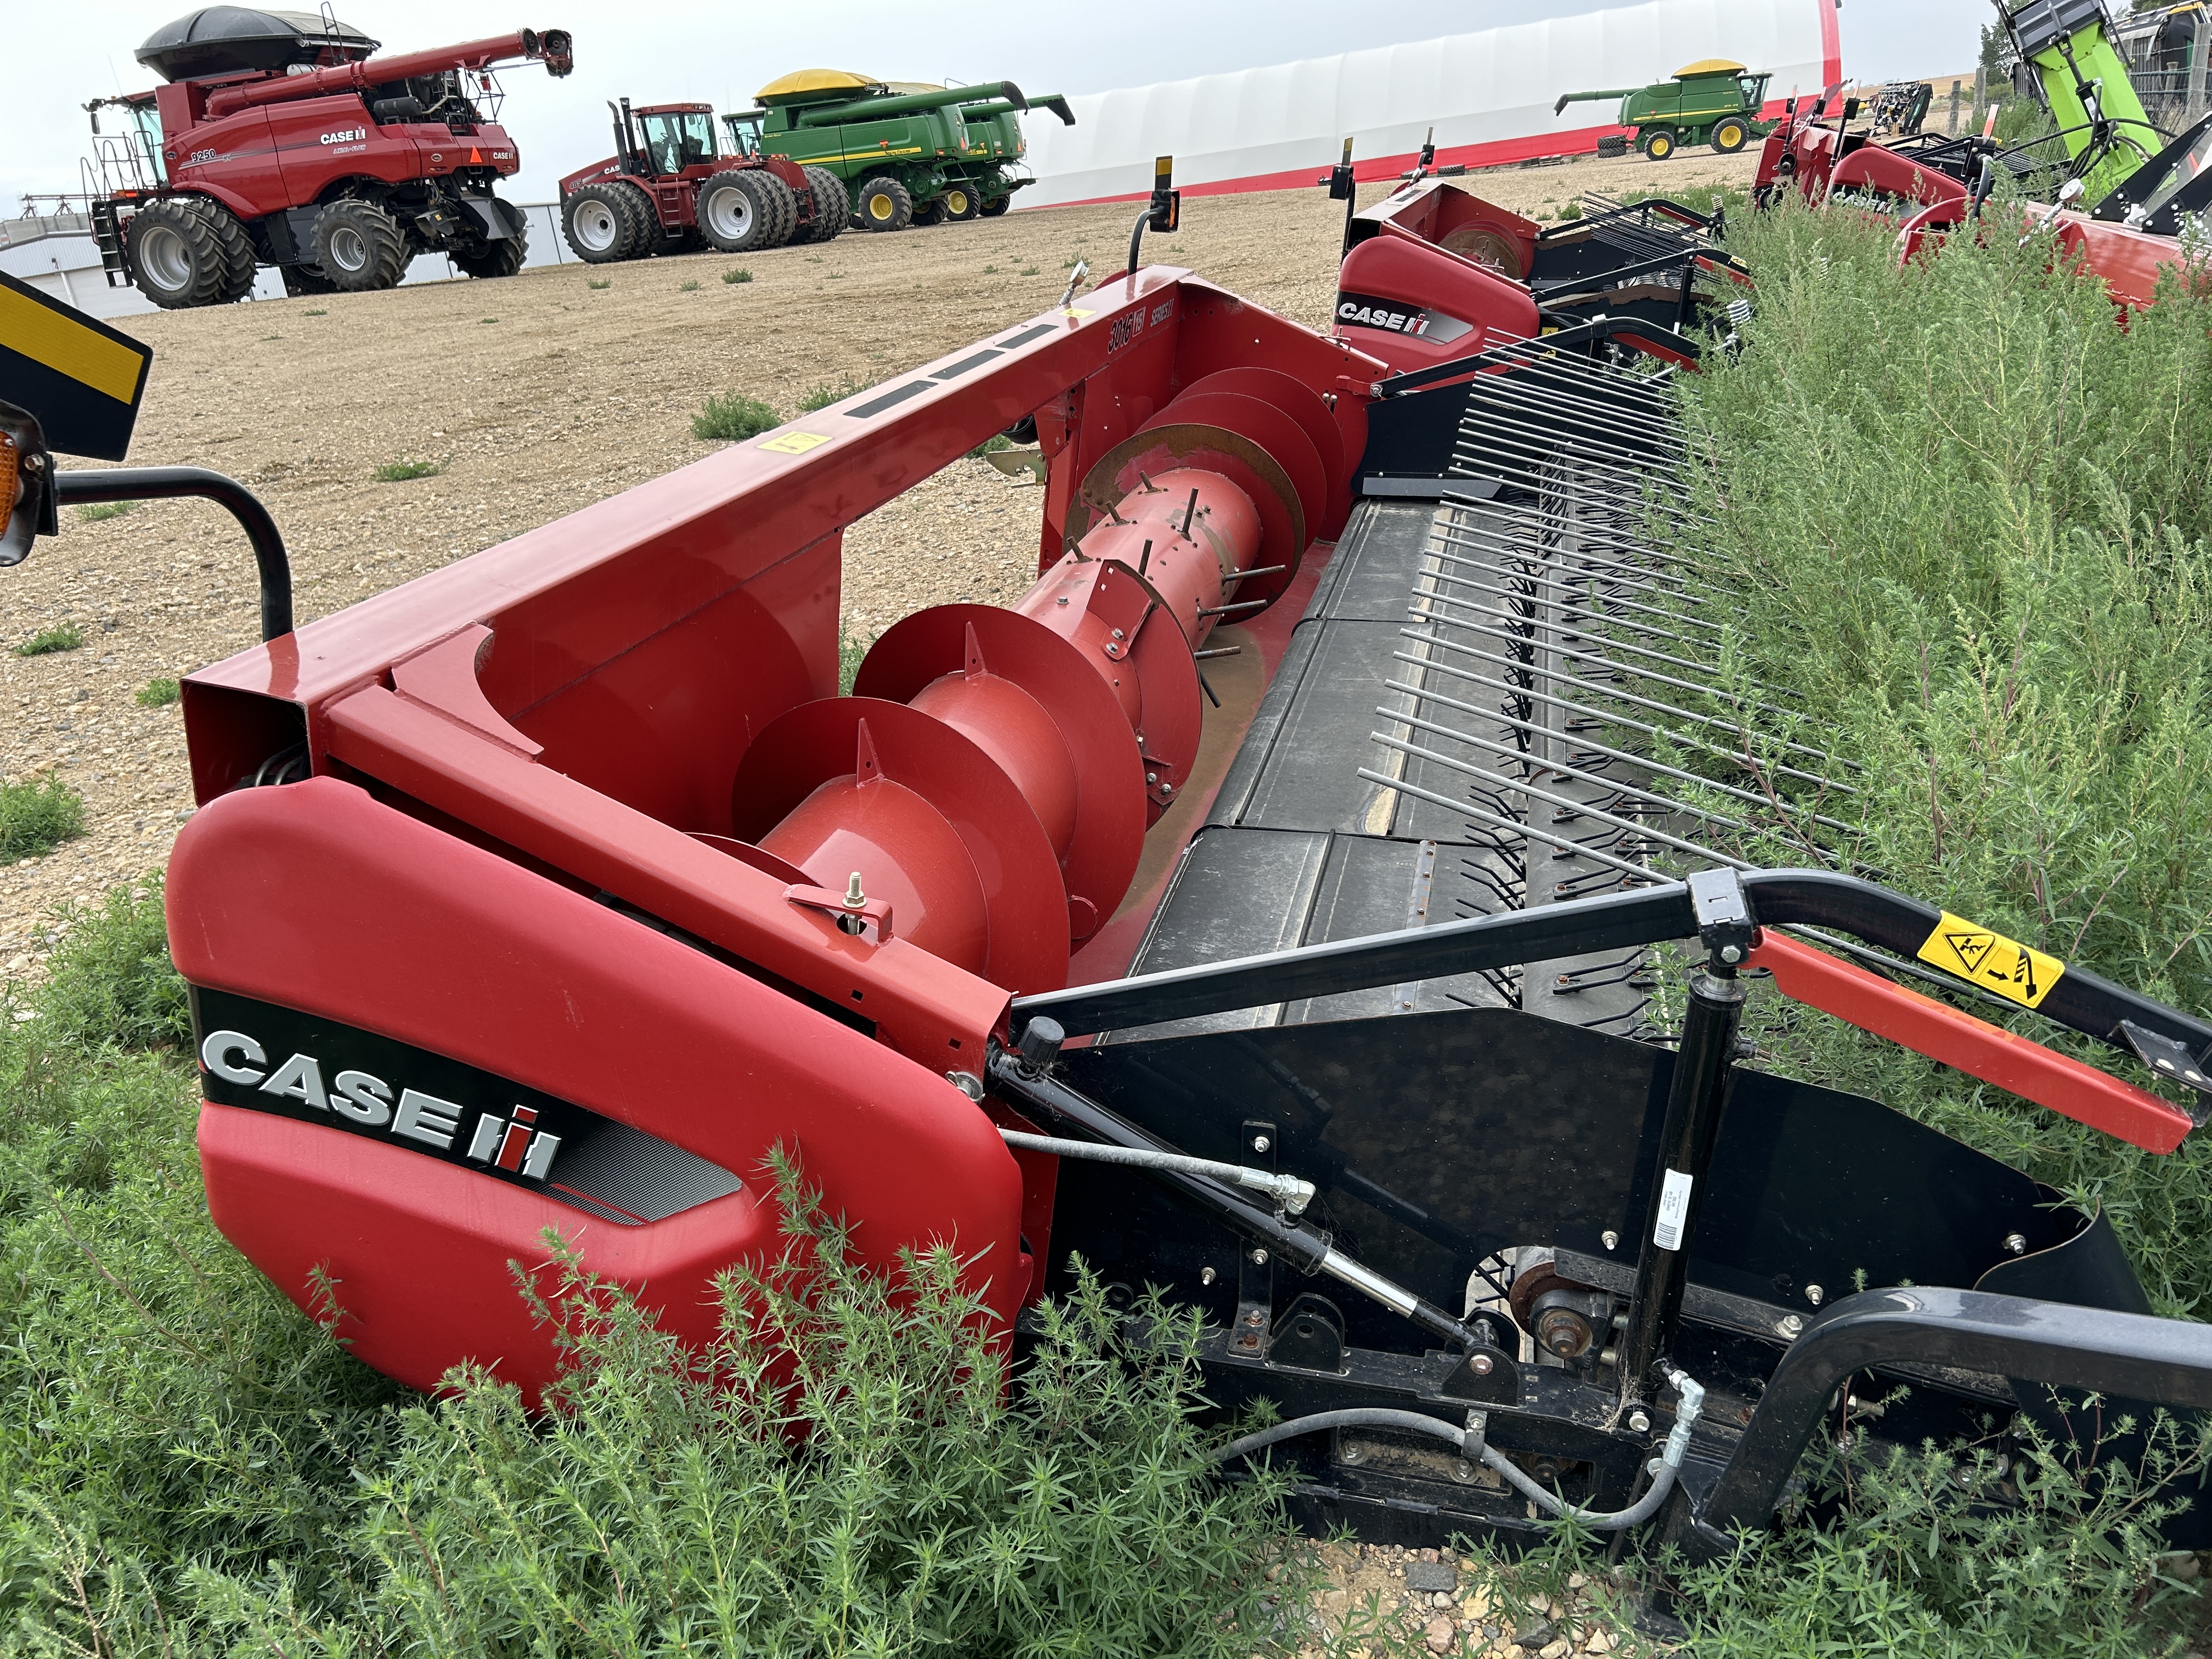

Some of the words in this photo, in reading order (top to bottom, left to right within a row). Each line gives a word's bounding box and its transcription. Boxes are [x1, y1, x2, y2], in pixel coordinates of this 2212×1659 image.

[320, 131, 354, 145] CASE
[191, 148, 216, 162] 9250
[569, 178, 582, 189] 485
[1108, 312, 1133, 354] 3016
[1150, 301, 1169, 328] SERIES
[1339, 303, 1406, 330] CASE
[1403, 313, 1430, 335] IH
[201, 1030, 464, 1150] CASE
[467, 1104, 561, 1181] IH
